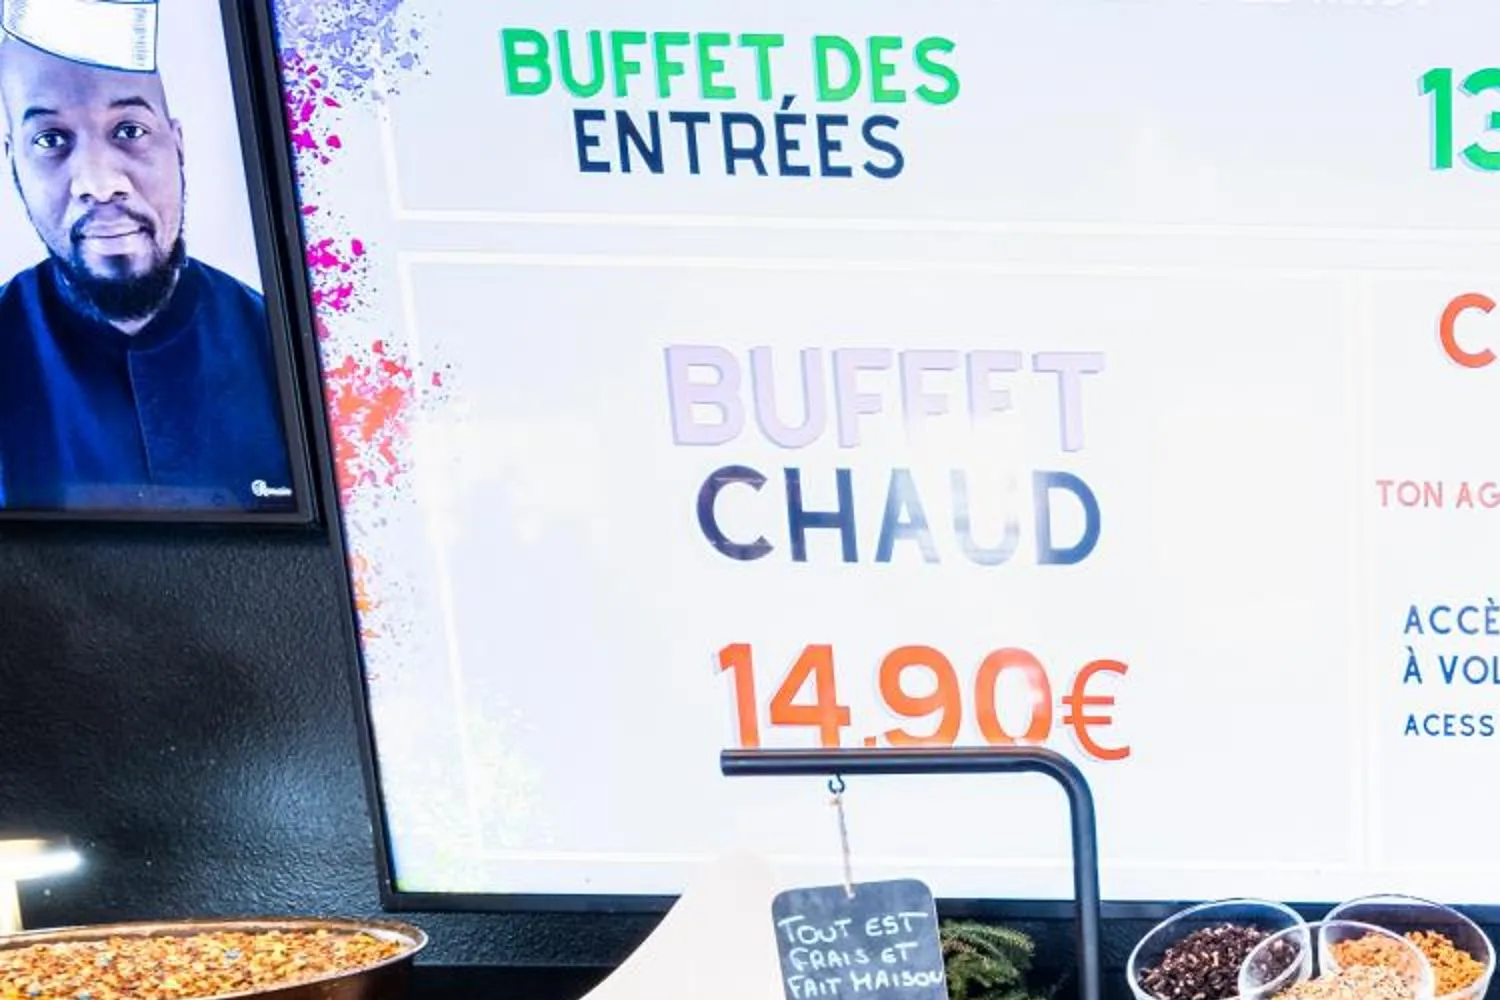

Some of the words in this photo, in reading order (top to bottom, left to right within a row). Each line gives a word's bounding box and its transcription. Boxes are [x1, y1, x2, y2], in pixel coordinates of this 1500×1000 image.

[499, 28, 784, 101] BUFFET
[811, 35, 960, 105] DES
[573, 94, 905, 179] ENTRÉES
[1375, 479, 1444, 508] TON
[696, 464, 1102, 566] CHAUD
[1403, 646, 1423, 685] À
[1404, 714, 1495, 737] ACESS
[865, 913, 929, 937] EST
[789, 947, 870, 972] FRAIS
[881, 942, 919, 964] ET
[787, 975, 842, 999] FAIT
[850, 969, 944, 992] MAISON
